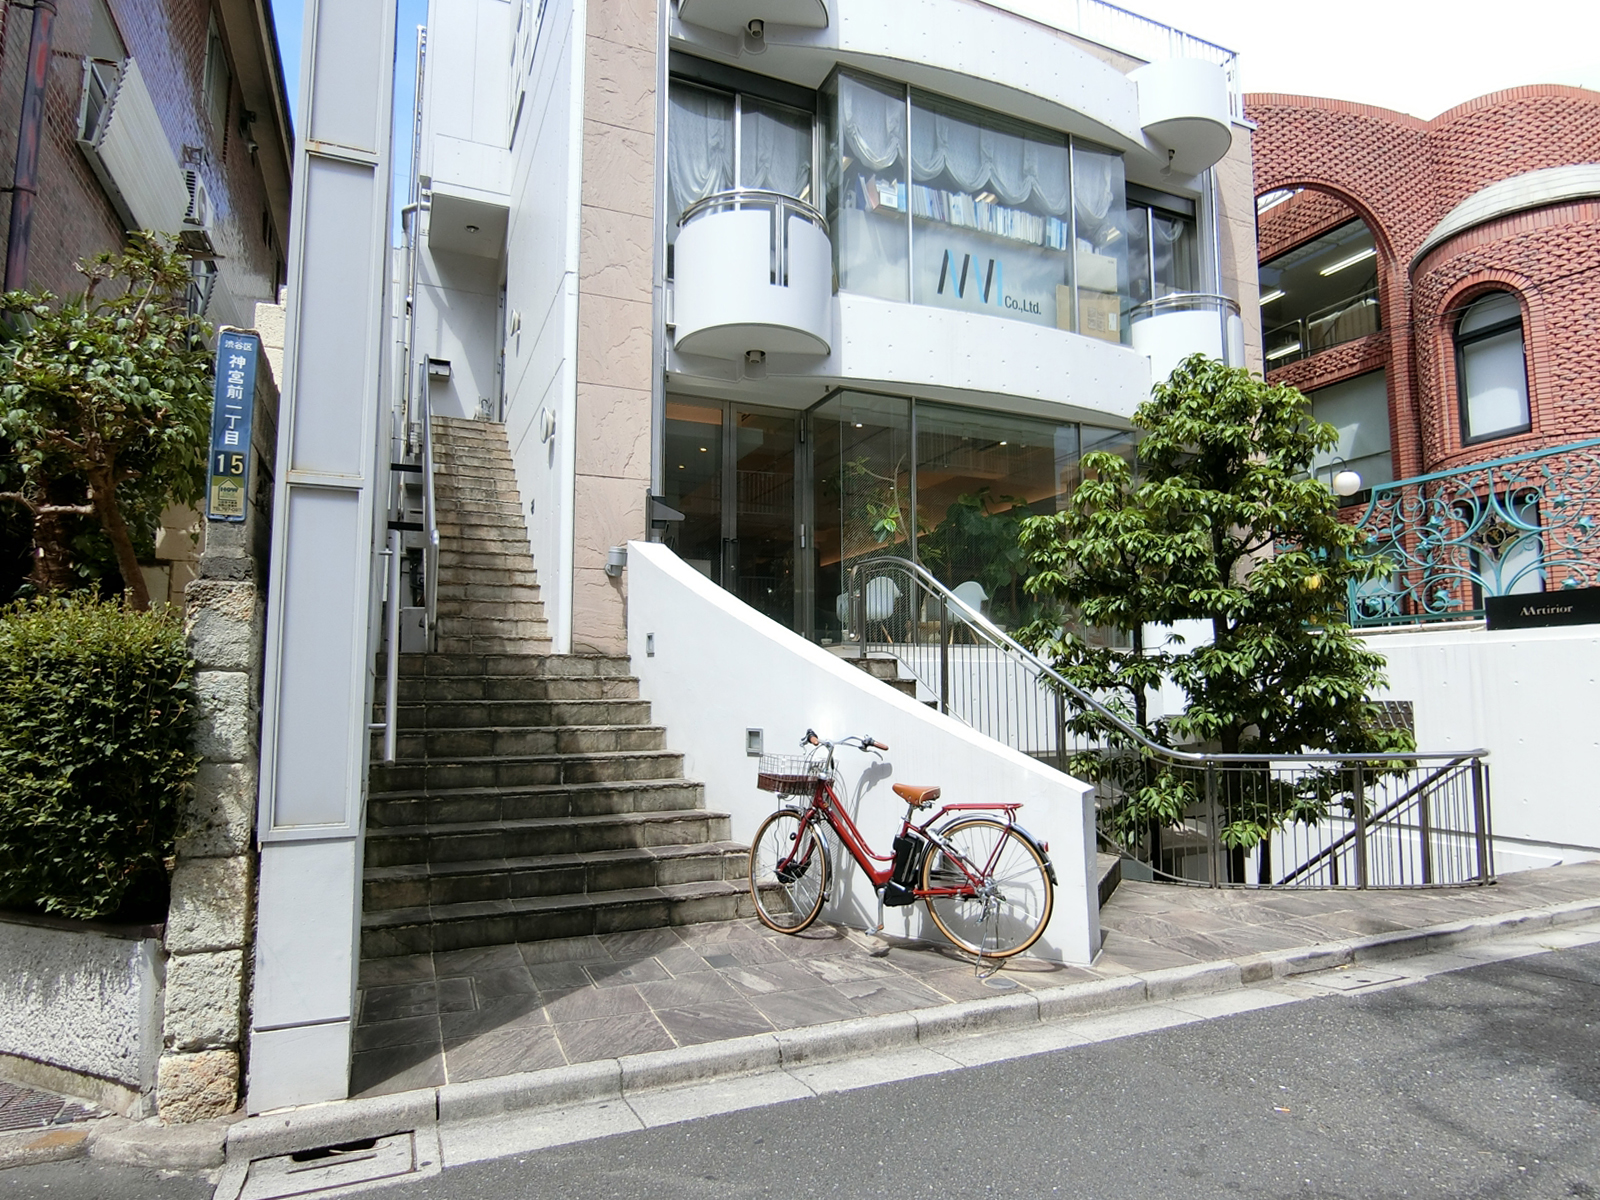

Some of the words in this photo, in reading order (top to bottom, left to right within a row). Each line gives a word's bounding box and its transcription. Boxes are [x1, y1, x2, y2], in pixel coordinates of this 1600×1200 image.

[224, 340, 252, 351] 渋谷区
[224, 354, 246, 445] 神宮前一丁目
[217, 454, 243, 474] 15
